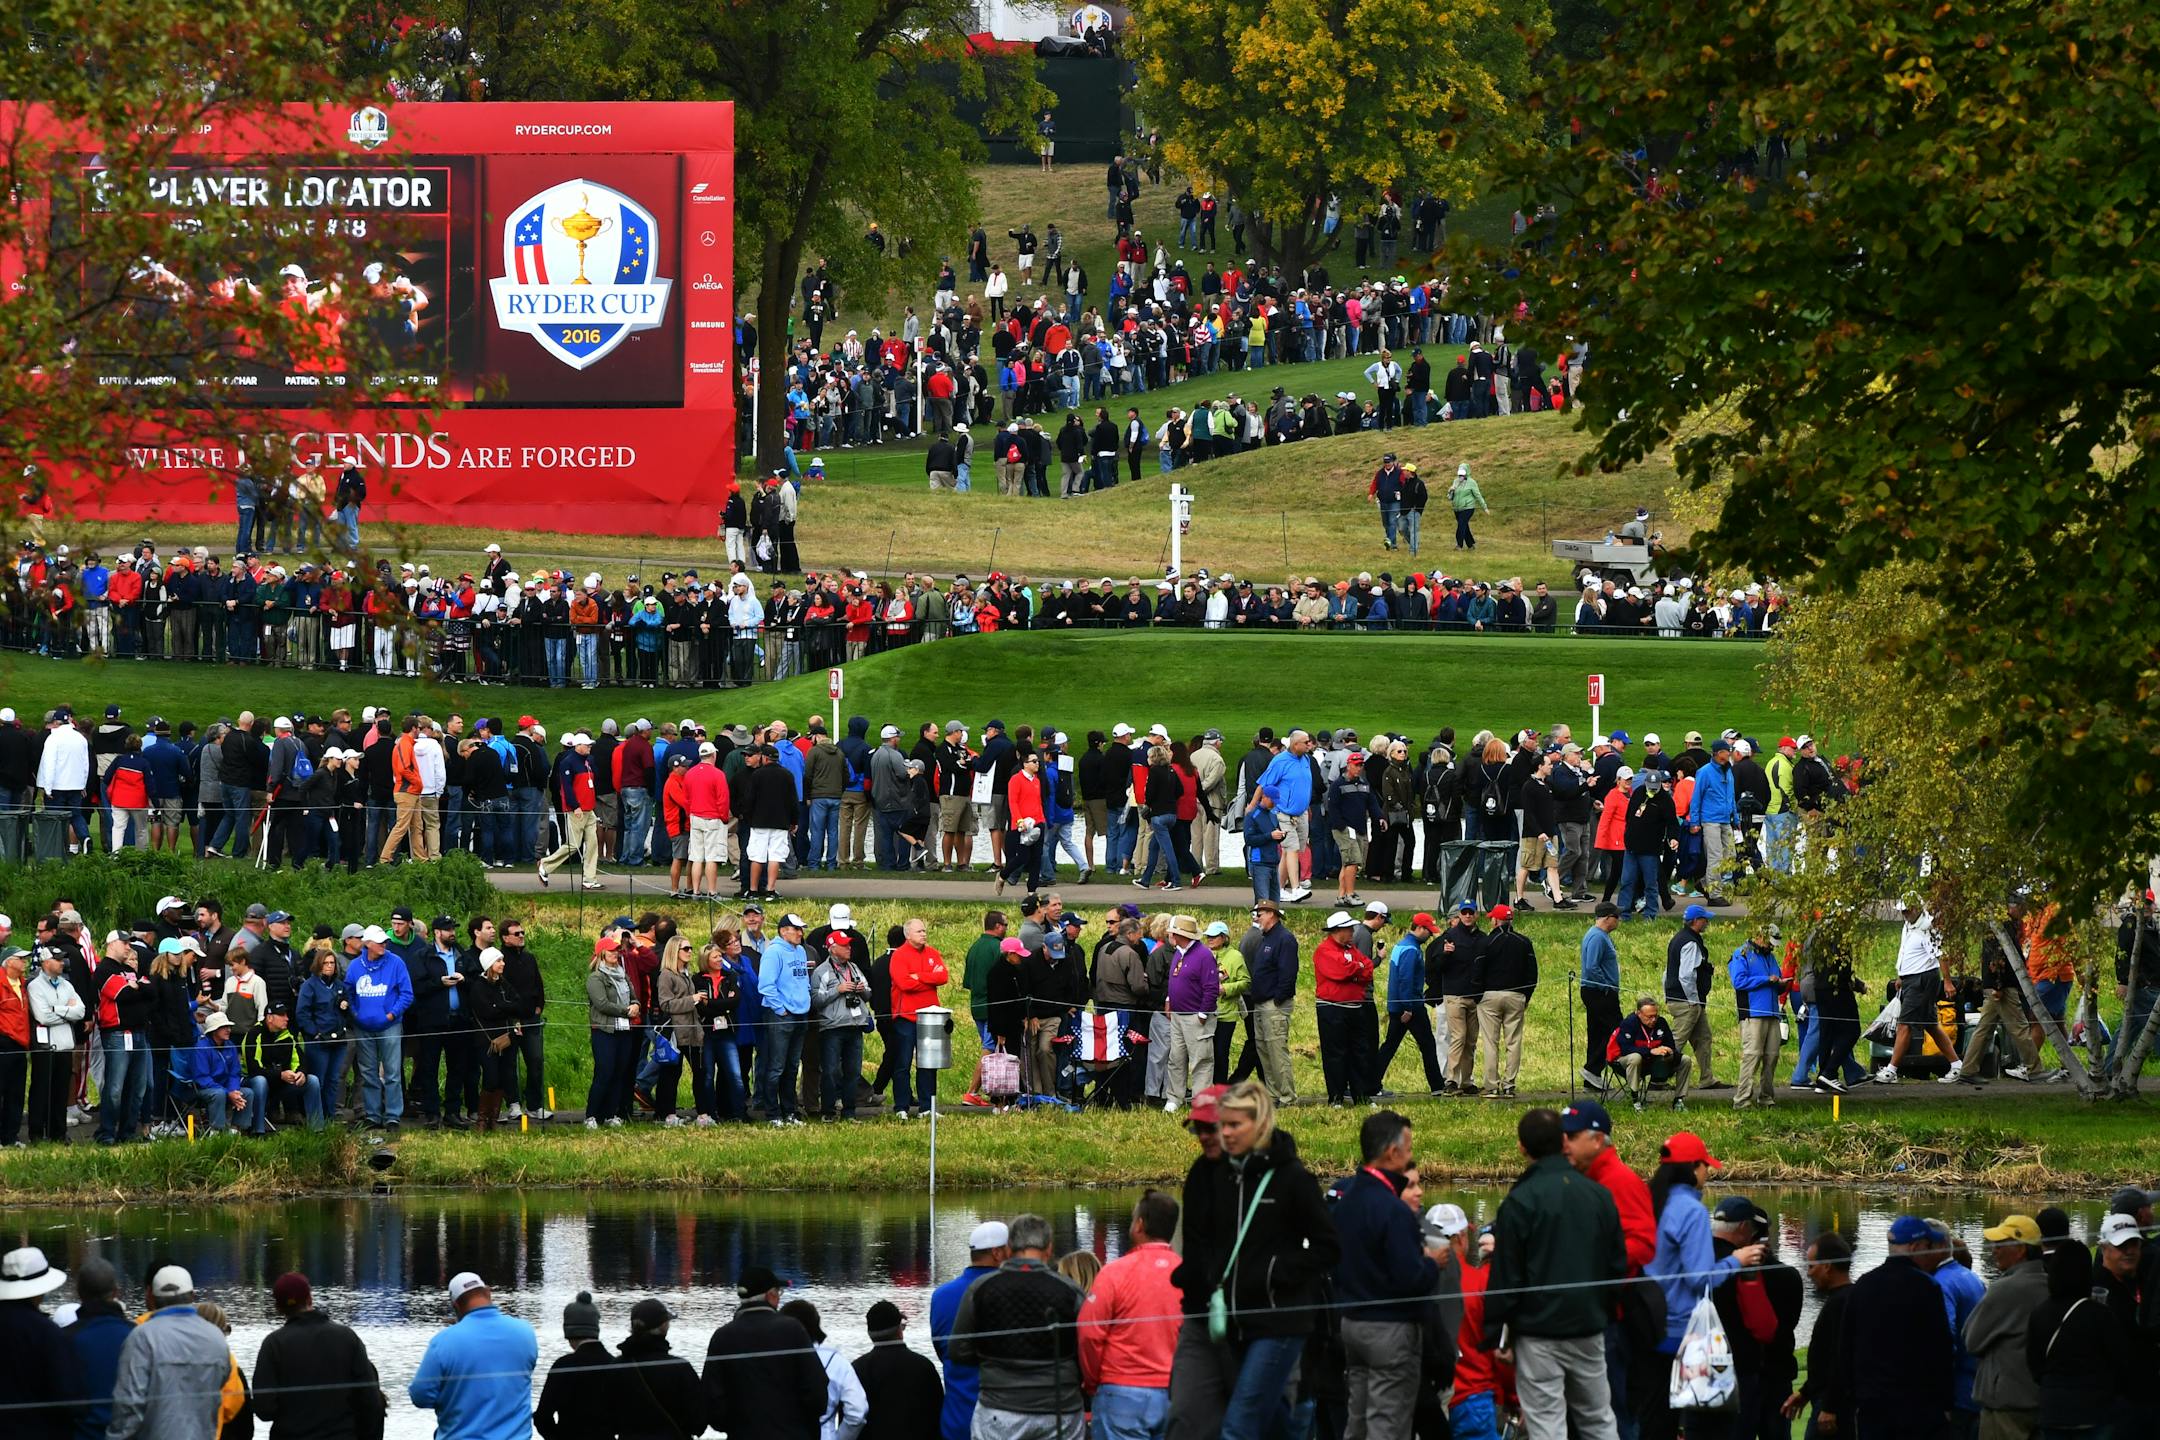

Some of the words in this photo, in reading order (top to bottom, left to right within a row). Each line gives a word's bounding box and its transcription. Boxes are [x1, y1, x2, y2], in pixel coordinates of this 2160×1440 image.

[514, 124, 612, 136] RYDERCUP.COM
[148, 177, 269, 206] PLAYER
[284, 177, 432, 207] LOCATOR
[692, 282, 723, 290] OMEGA
[507, 293, 597, 314] RYDER
[601, 293, 656, 314] CUP
[561, 329, 601, 344] 2016
[222, 376, 258, 385] KCHAR
[284, 376, 320, 386] PATRICK
[126, 447, 226, 469] WHERE
[457, 447, 512, 469] ARE
[521, 446, 636, 468] FORGED
[1590, 682, 1599, 697] 17
